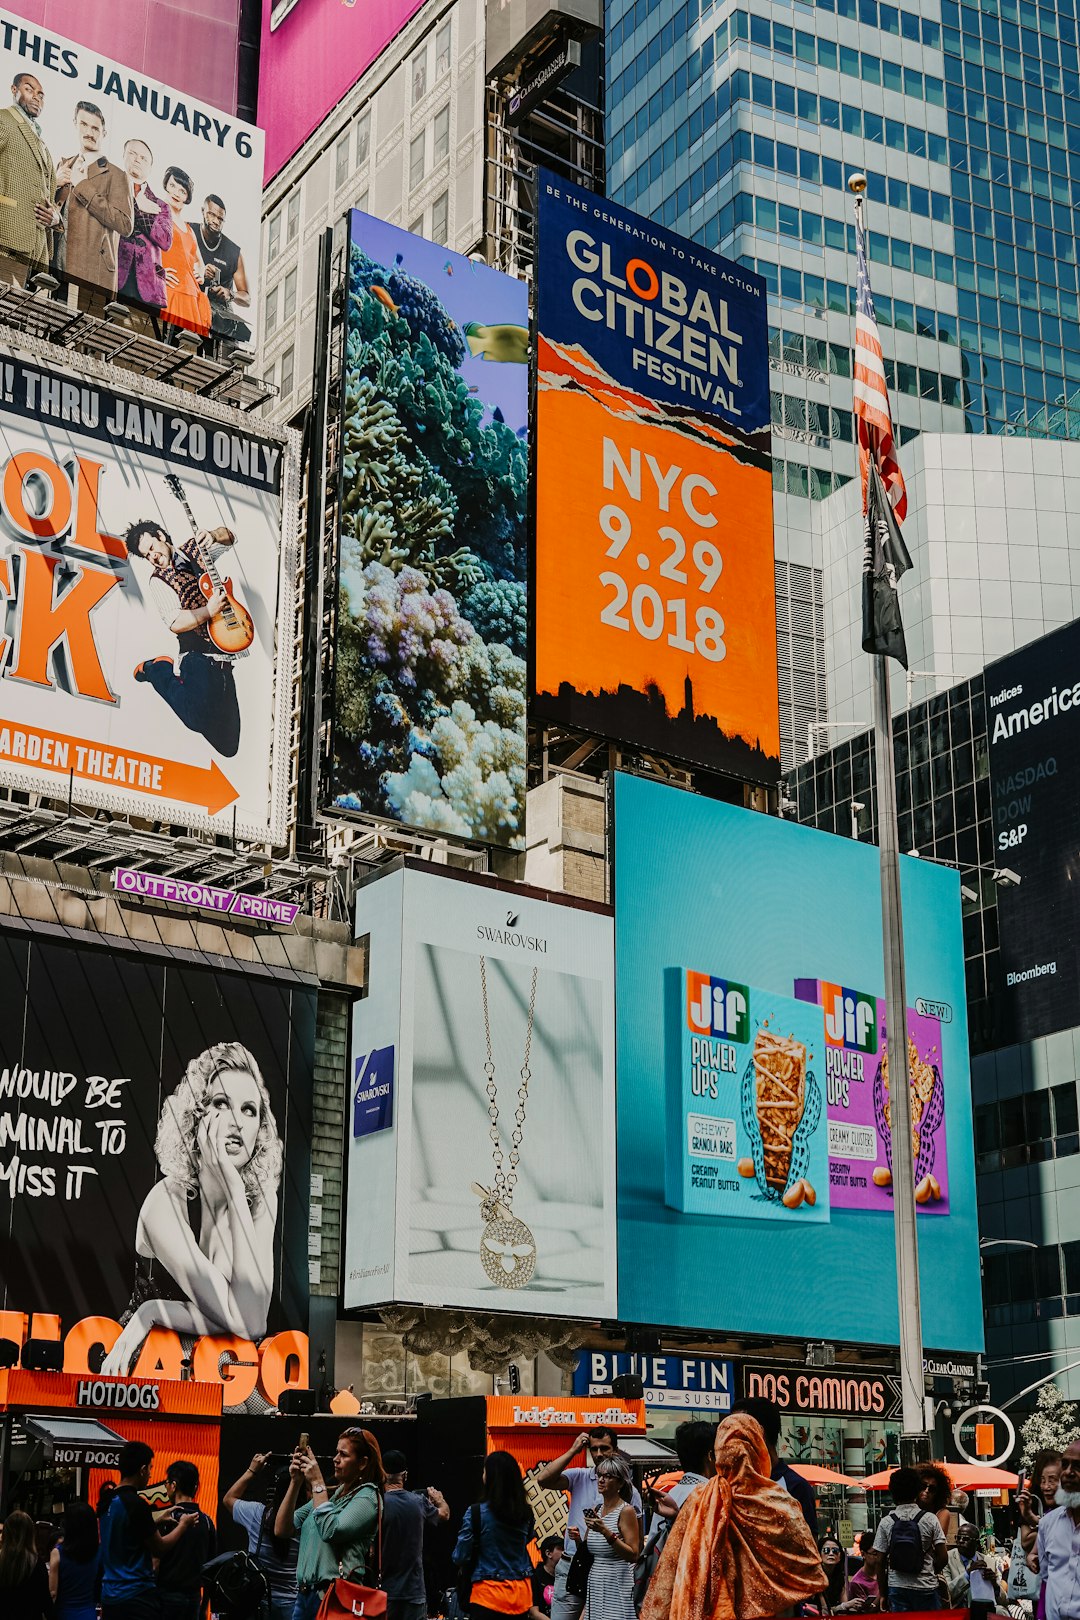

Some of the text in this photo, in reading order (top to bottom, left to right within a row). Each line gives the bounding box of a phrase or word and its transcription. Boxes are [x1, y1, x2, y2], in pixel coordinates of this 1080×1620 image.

[1, 20, 253, 158] THES JANUARY 6
[546, 184, 760, 297] BE THE GENERATION TO TAKE ACTION
[566, 229, 743, 345] GLOBAL
[572, 277, 739, 386] CITIZEN
[632, 347, 742, 416] FESTIVAL
[22, 368, 101, 429] THRU
[105, 399, 164, 450] JAN
[170, 416, 207, 462] 20
[212, 430, 280, 485] ONLY
[602, 435, 719, 528] NYC
[598, 504, 724, 594] 9.29
[598, 571, 727, 662] 2018
[990, 684, 1023, 708] Indices
[0, 728, 163, 791] ARDEN THEATRE
[996, 757, 1058, 797] NASDAQ
[998, 794, 1032, 824] DOW
[998, 823, 1028, 851] S&P
[120, 873, 293, 922] OUTFRONT PRIME
[476, 925, 547, 953] SWAROVSKI
[1006, 961, 1057, 986] Bloomberg
[690, 983, 747, 1035] Jif
[825, 994, 875, 1047] Jif
[920, 1002, 948, 1019] NEW!
[691, 1037, 737, 1074] POWER
[825, 1046, 865, 1082] POWER
[84, 1076, 132, 1108] BE
[356, 1083, 390, 1103] SWAROVSKI
[691, 1061, 719, 1099] UPS
[827, 1070, 849, 1108] UPS
[95, 1120, 126, 1155] TO
[692, 1136, 733, 1155] GRANOLA BARS
[694, 1122, 730, 1138] CHEWY
[829, 1128, 850, 1144] CREAMY
[65, 1165, 99, 1200] IT
[691, 1164, 719, 1178] CREAMY
[691, 1177, 740, 1191] PEANUT BUTTER
[829, 1162, 850, 1175] CREAMY
[829, 1174, 867, 1188] PEANUT BUTTER
[682, 1360, 728, 1390] FIN
[78, 1380, 160, 1410] HOTDOGS
[684, 1393, 728, 1406] SUSHI
[749, 1373, 885, 1413] DOS CAMINOS
[513, 1406, 638, 1427] belgian waffles
[54, 1449, 120, 1465] HOT DOGS
